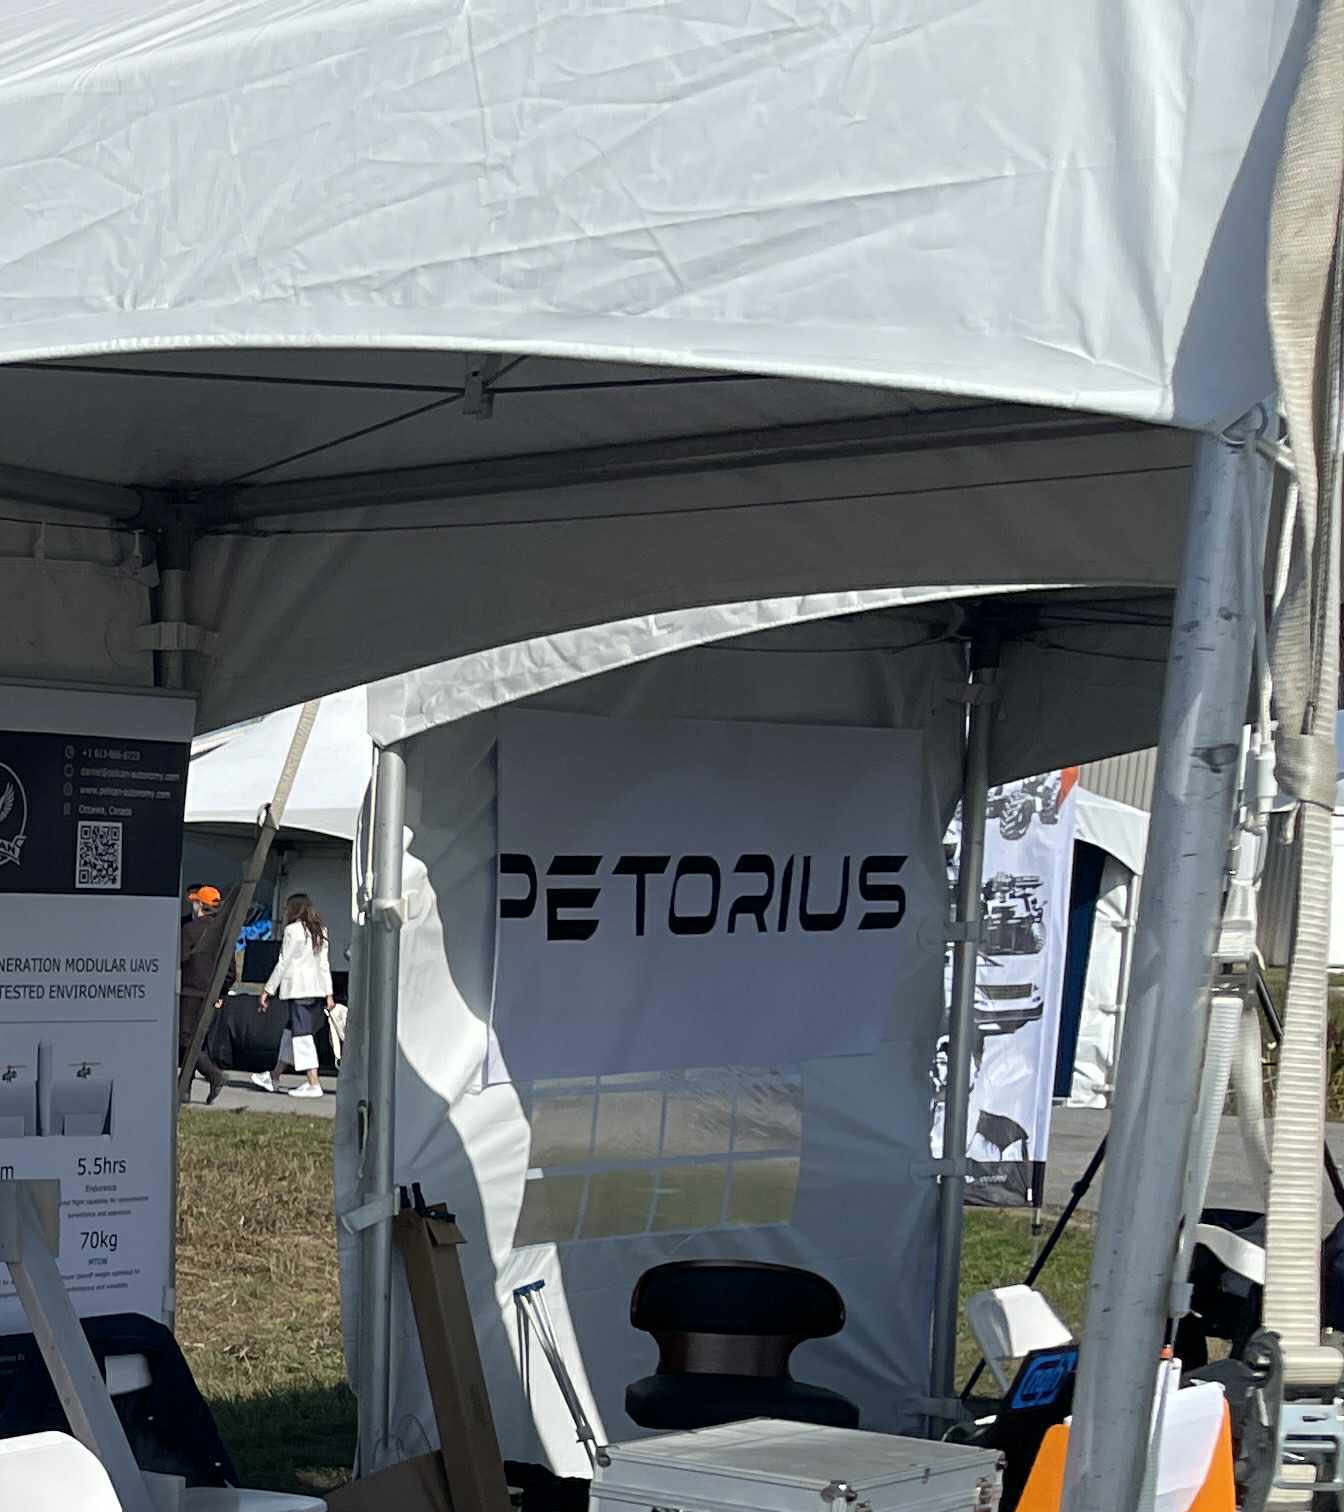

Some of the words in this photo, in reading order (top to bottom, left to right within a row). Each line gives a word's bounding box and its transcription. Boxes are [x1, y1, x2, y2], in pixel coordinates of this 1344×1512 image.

[65, 957, 126, 974] MODULAR
[49, 983, 146, 1000] ENVIRONMENTS
[77, 1157, 127, 1177] 5.5hrs
[80, 1231, 118, 1252] 70kg
